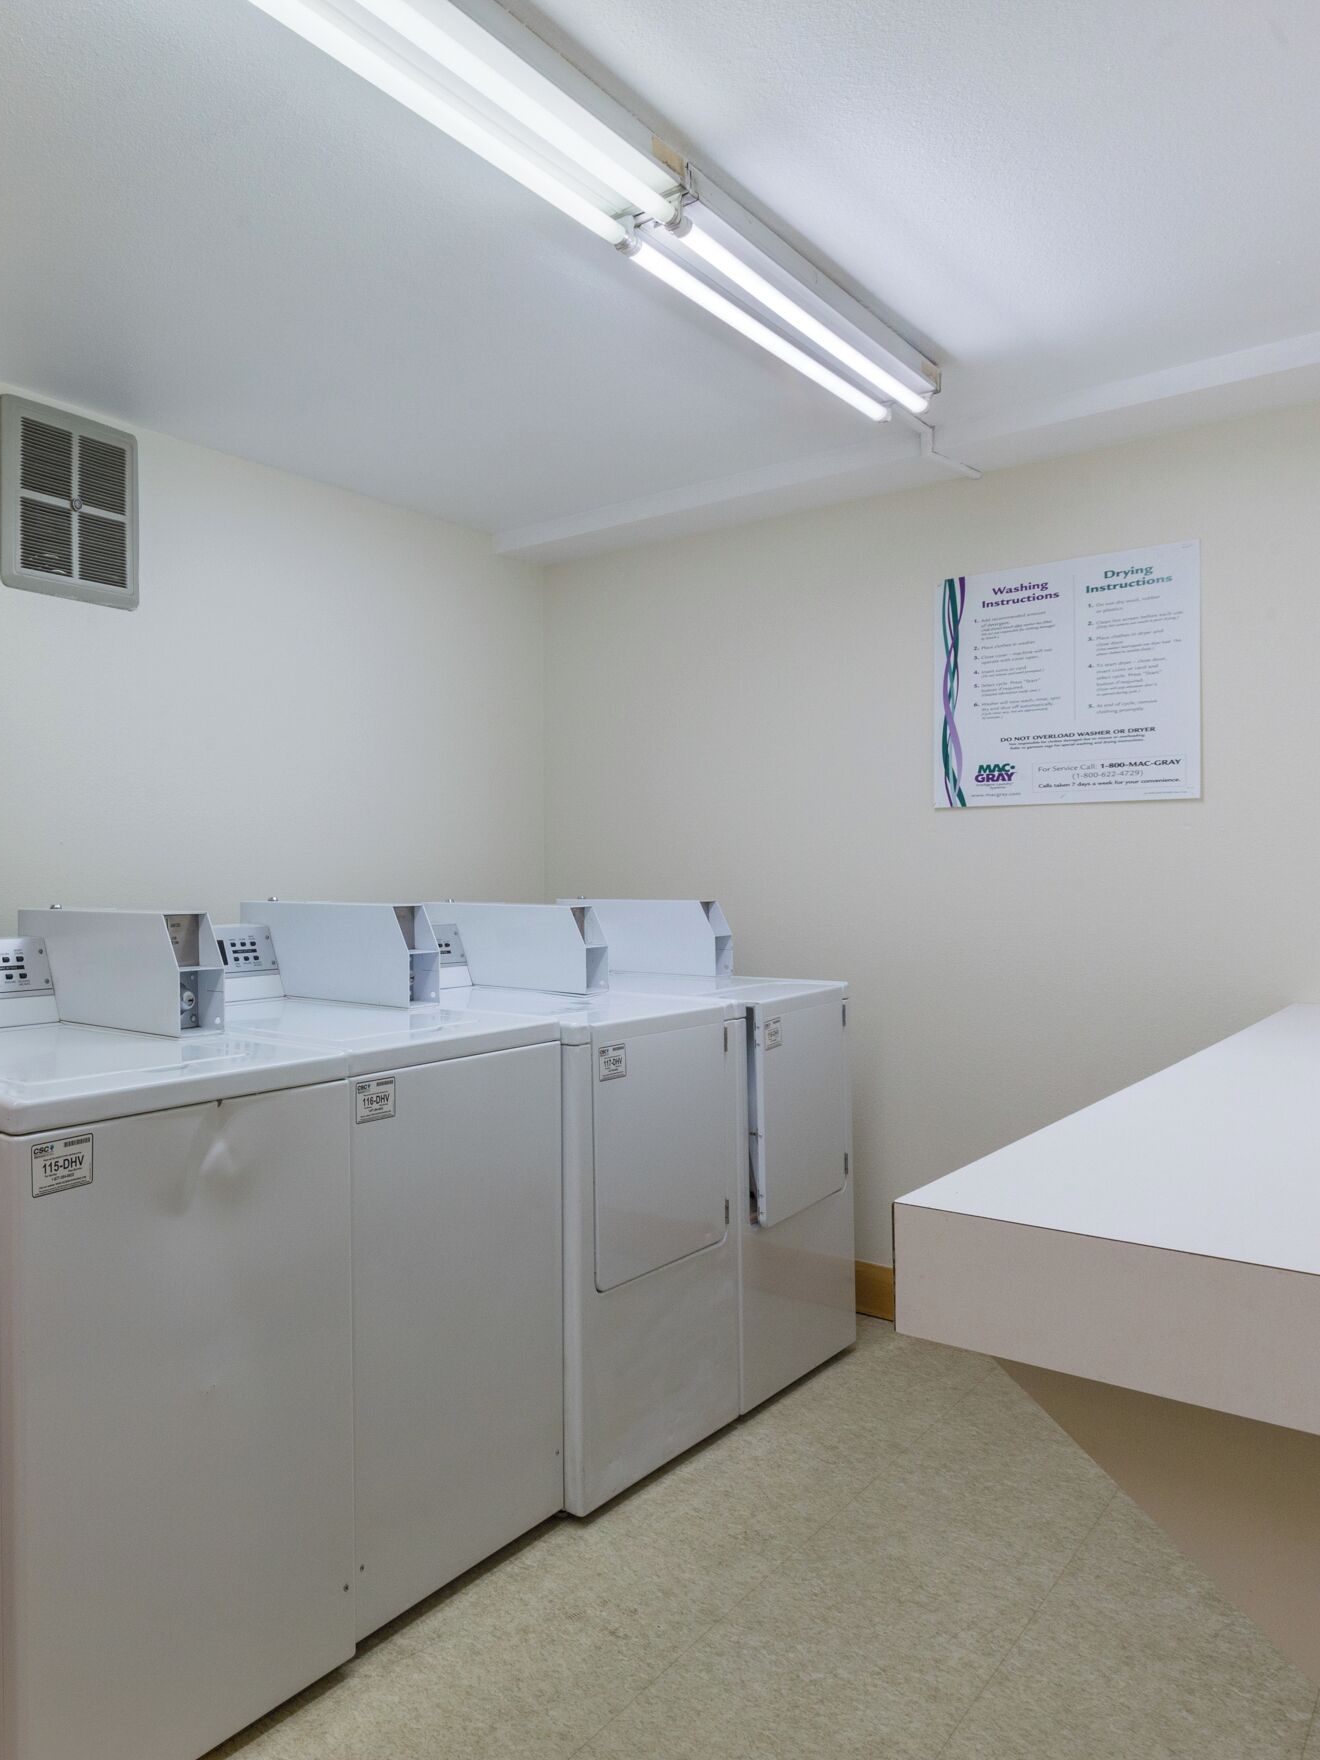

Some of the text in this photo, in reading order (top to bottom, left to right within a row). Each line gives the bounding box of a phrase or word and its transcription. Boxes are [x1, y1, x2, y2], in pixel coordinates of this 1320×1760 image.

[1104, 565, 1154, 579] Drying
[992, 582, 1049, 595] Washing
[1085, 575, 1173, 593] Instructions
[982, 592, 1060, 608] Instructions
[1032, 732, 1075, 740] OVERLOAD
[1077, 728, 1111, 737] WASHER
[1100, 758, 1181, 769] 1-800-MAC-GRAY
[975, 772, 1016, 783] GRAY
[363, 1093, 390, 1107] 116-DHV
[34, 1146, 49, 1154] CSC
[42, 1154, 84, 1174] 115-DHV
